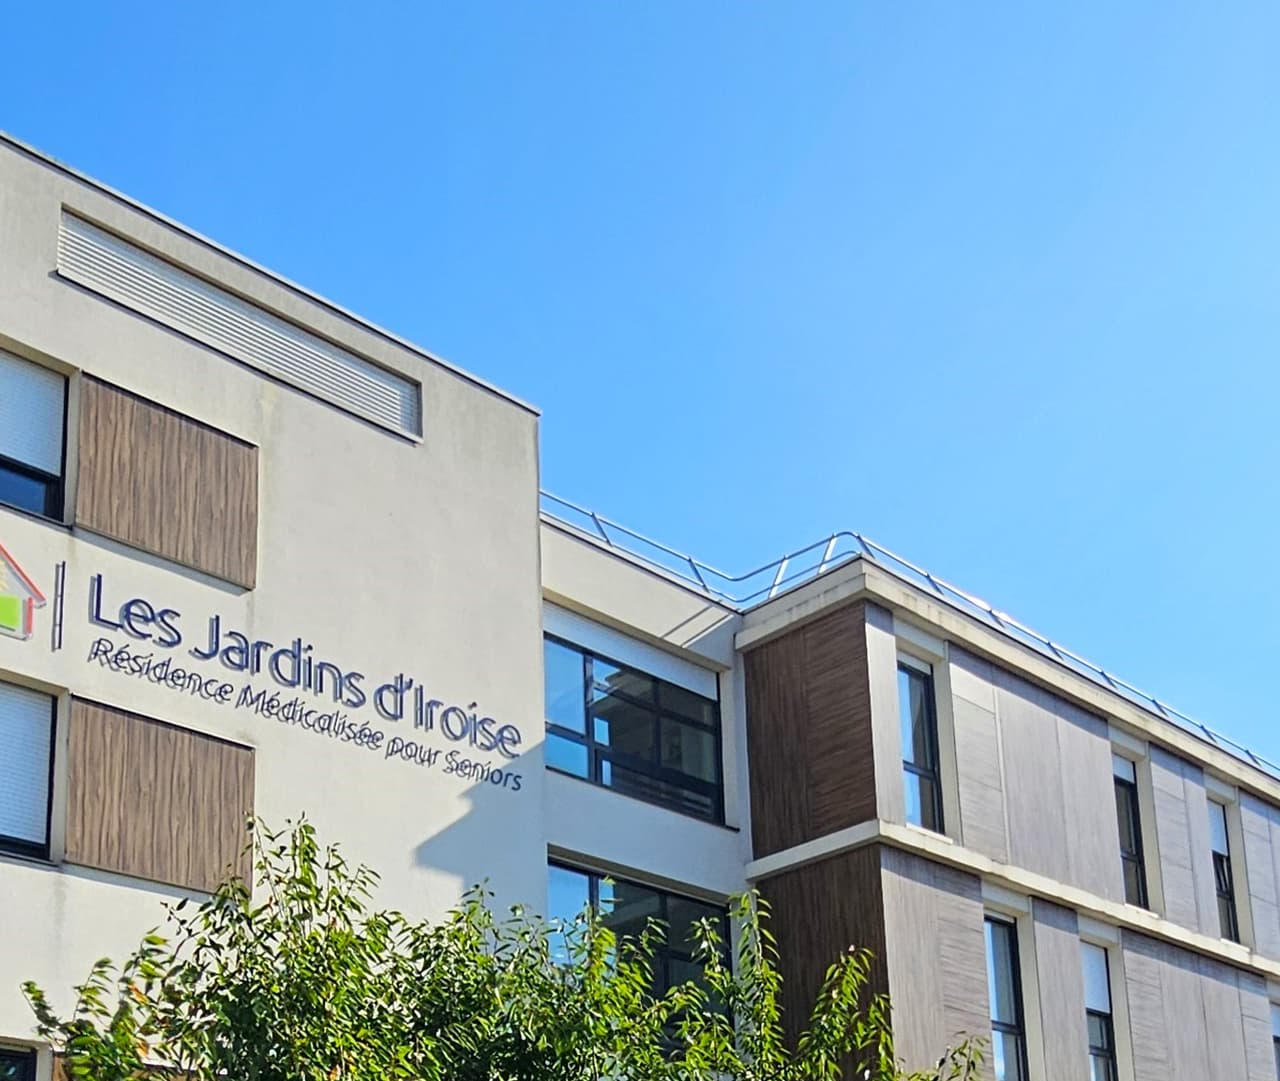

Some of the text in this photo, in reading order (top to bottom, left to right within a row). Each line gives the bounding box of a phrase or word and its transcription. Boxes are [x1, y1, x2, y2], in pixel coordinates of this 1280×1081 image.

[88, 637, 523, 792] Résidence Médicalisée pour Seniors
[89, 573, 522, 759] Les Jardins d'Iroise
